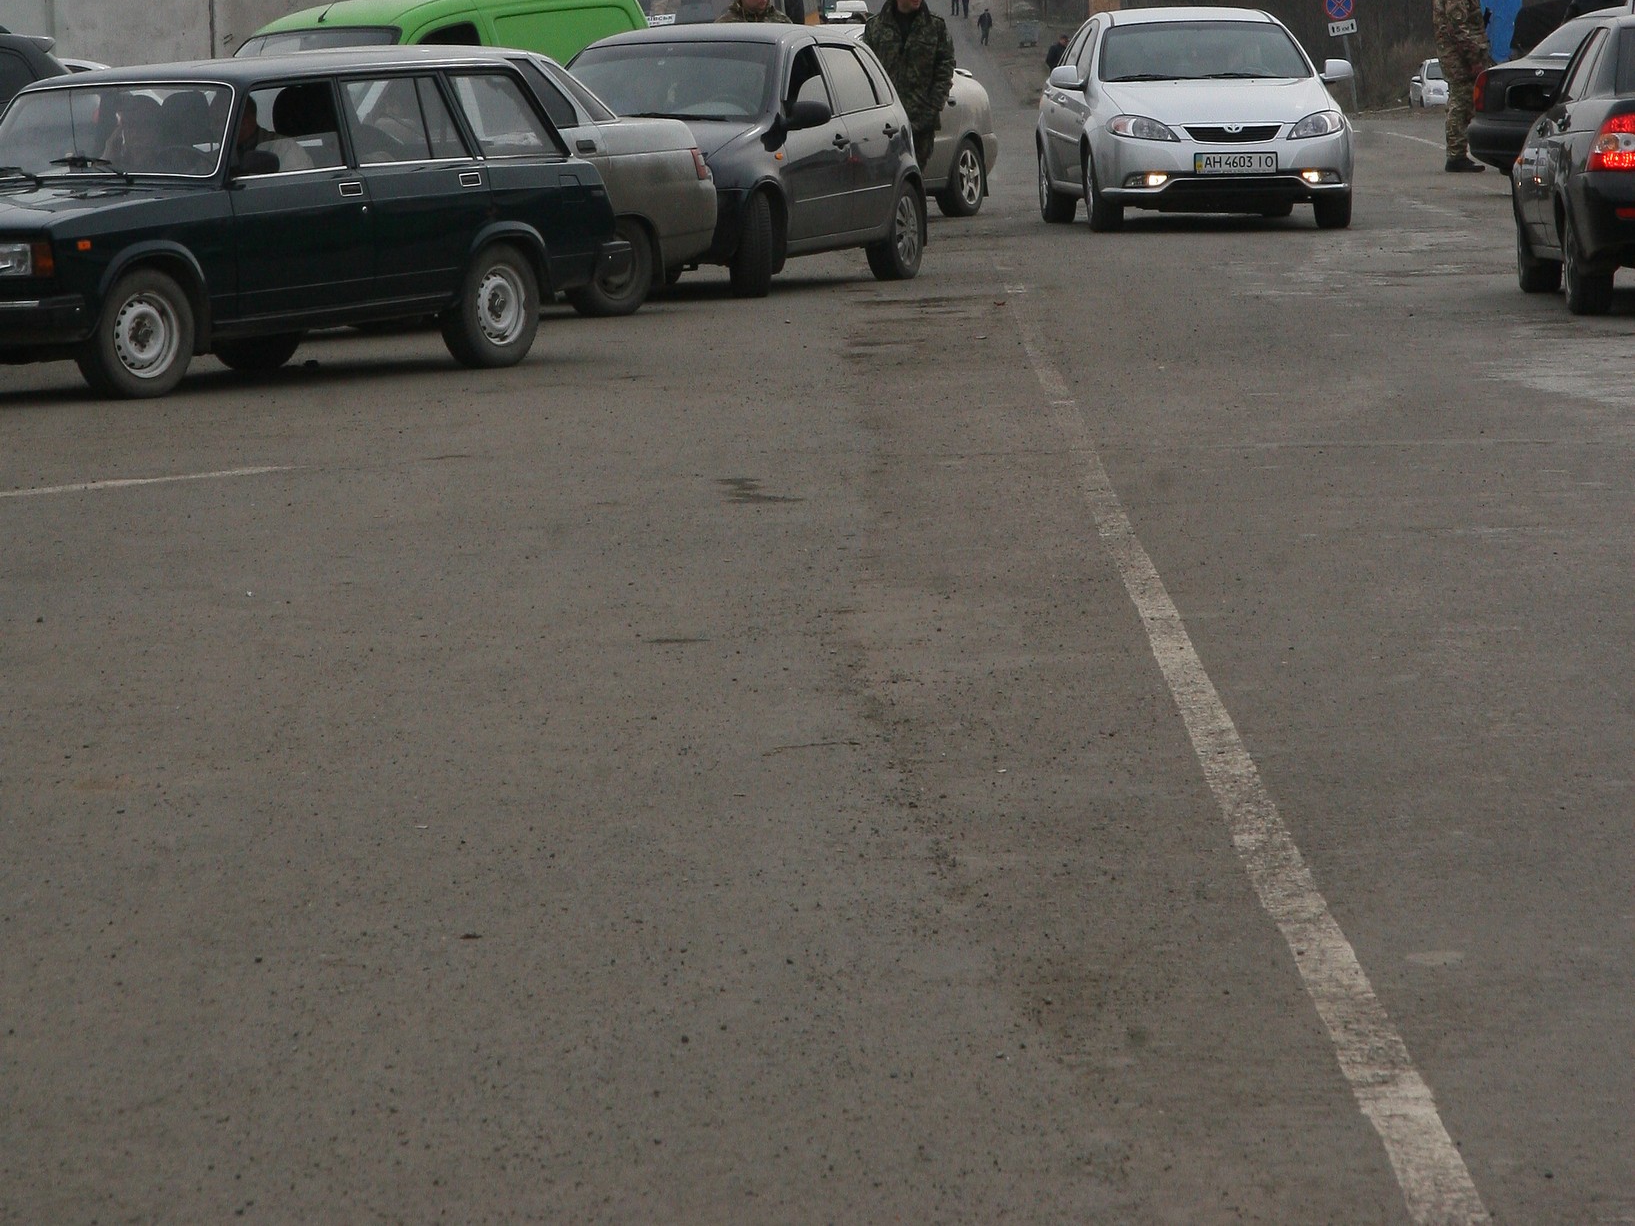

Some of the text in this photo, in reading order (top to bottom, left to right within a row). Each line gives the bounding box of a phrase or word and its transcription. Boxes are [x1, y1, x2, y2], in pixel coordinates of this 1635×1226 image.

[1204, 155, 1274, 169] AH 4603 IO
